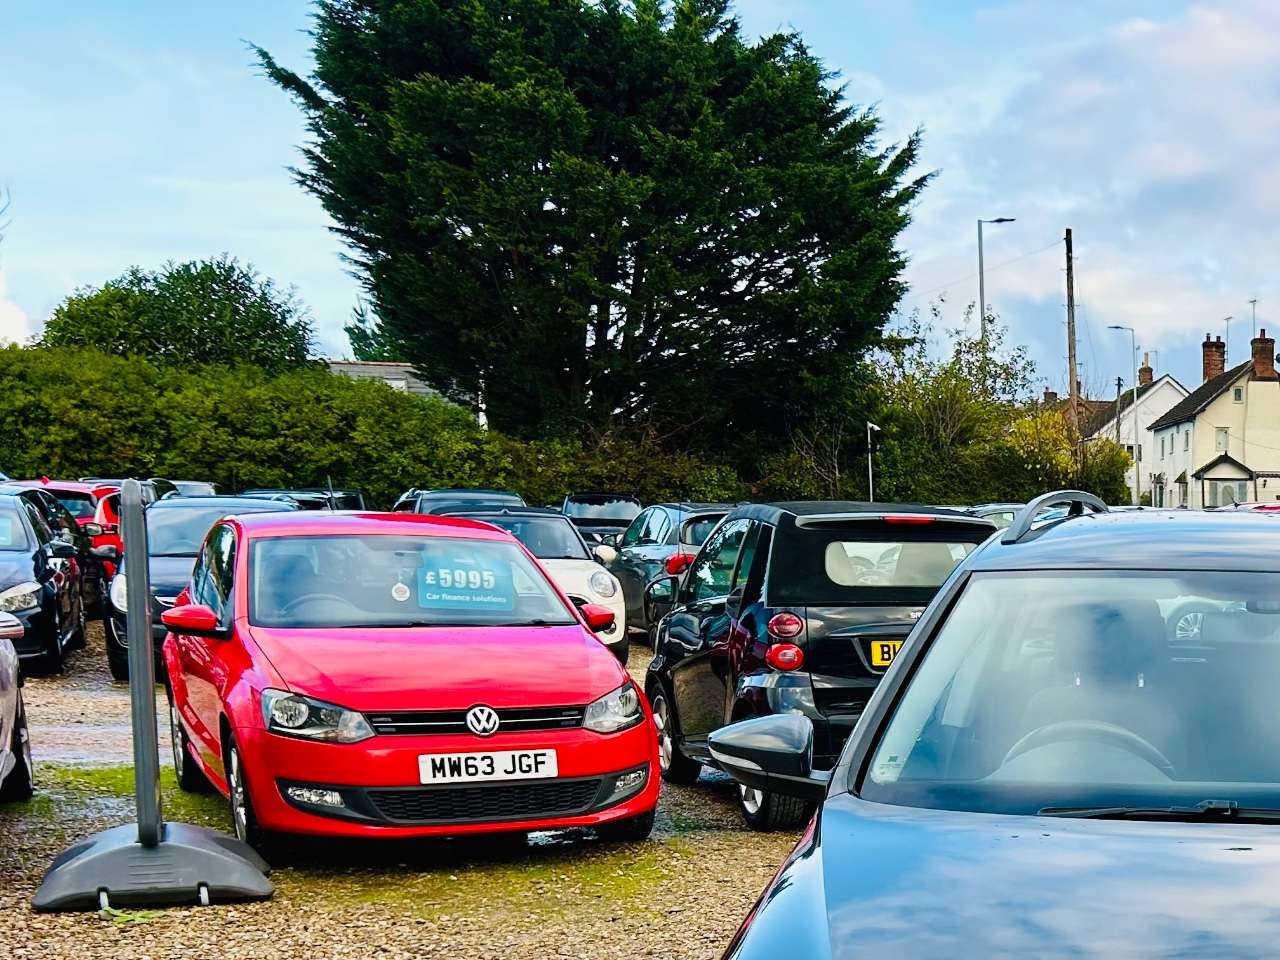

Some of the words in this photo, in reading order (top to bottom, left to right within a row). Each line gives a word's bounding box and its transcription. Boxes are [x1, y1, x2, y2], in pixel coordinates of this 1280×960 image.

[426, 592, 440, 600] Car
[441, 593, 470, 601] finance
[472, 595, 507, 603] solutions
[430, 756, 495, 778] MW63
[503, 752, 547, 775] JGF
